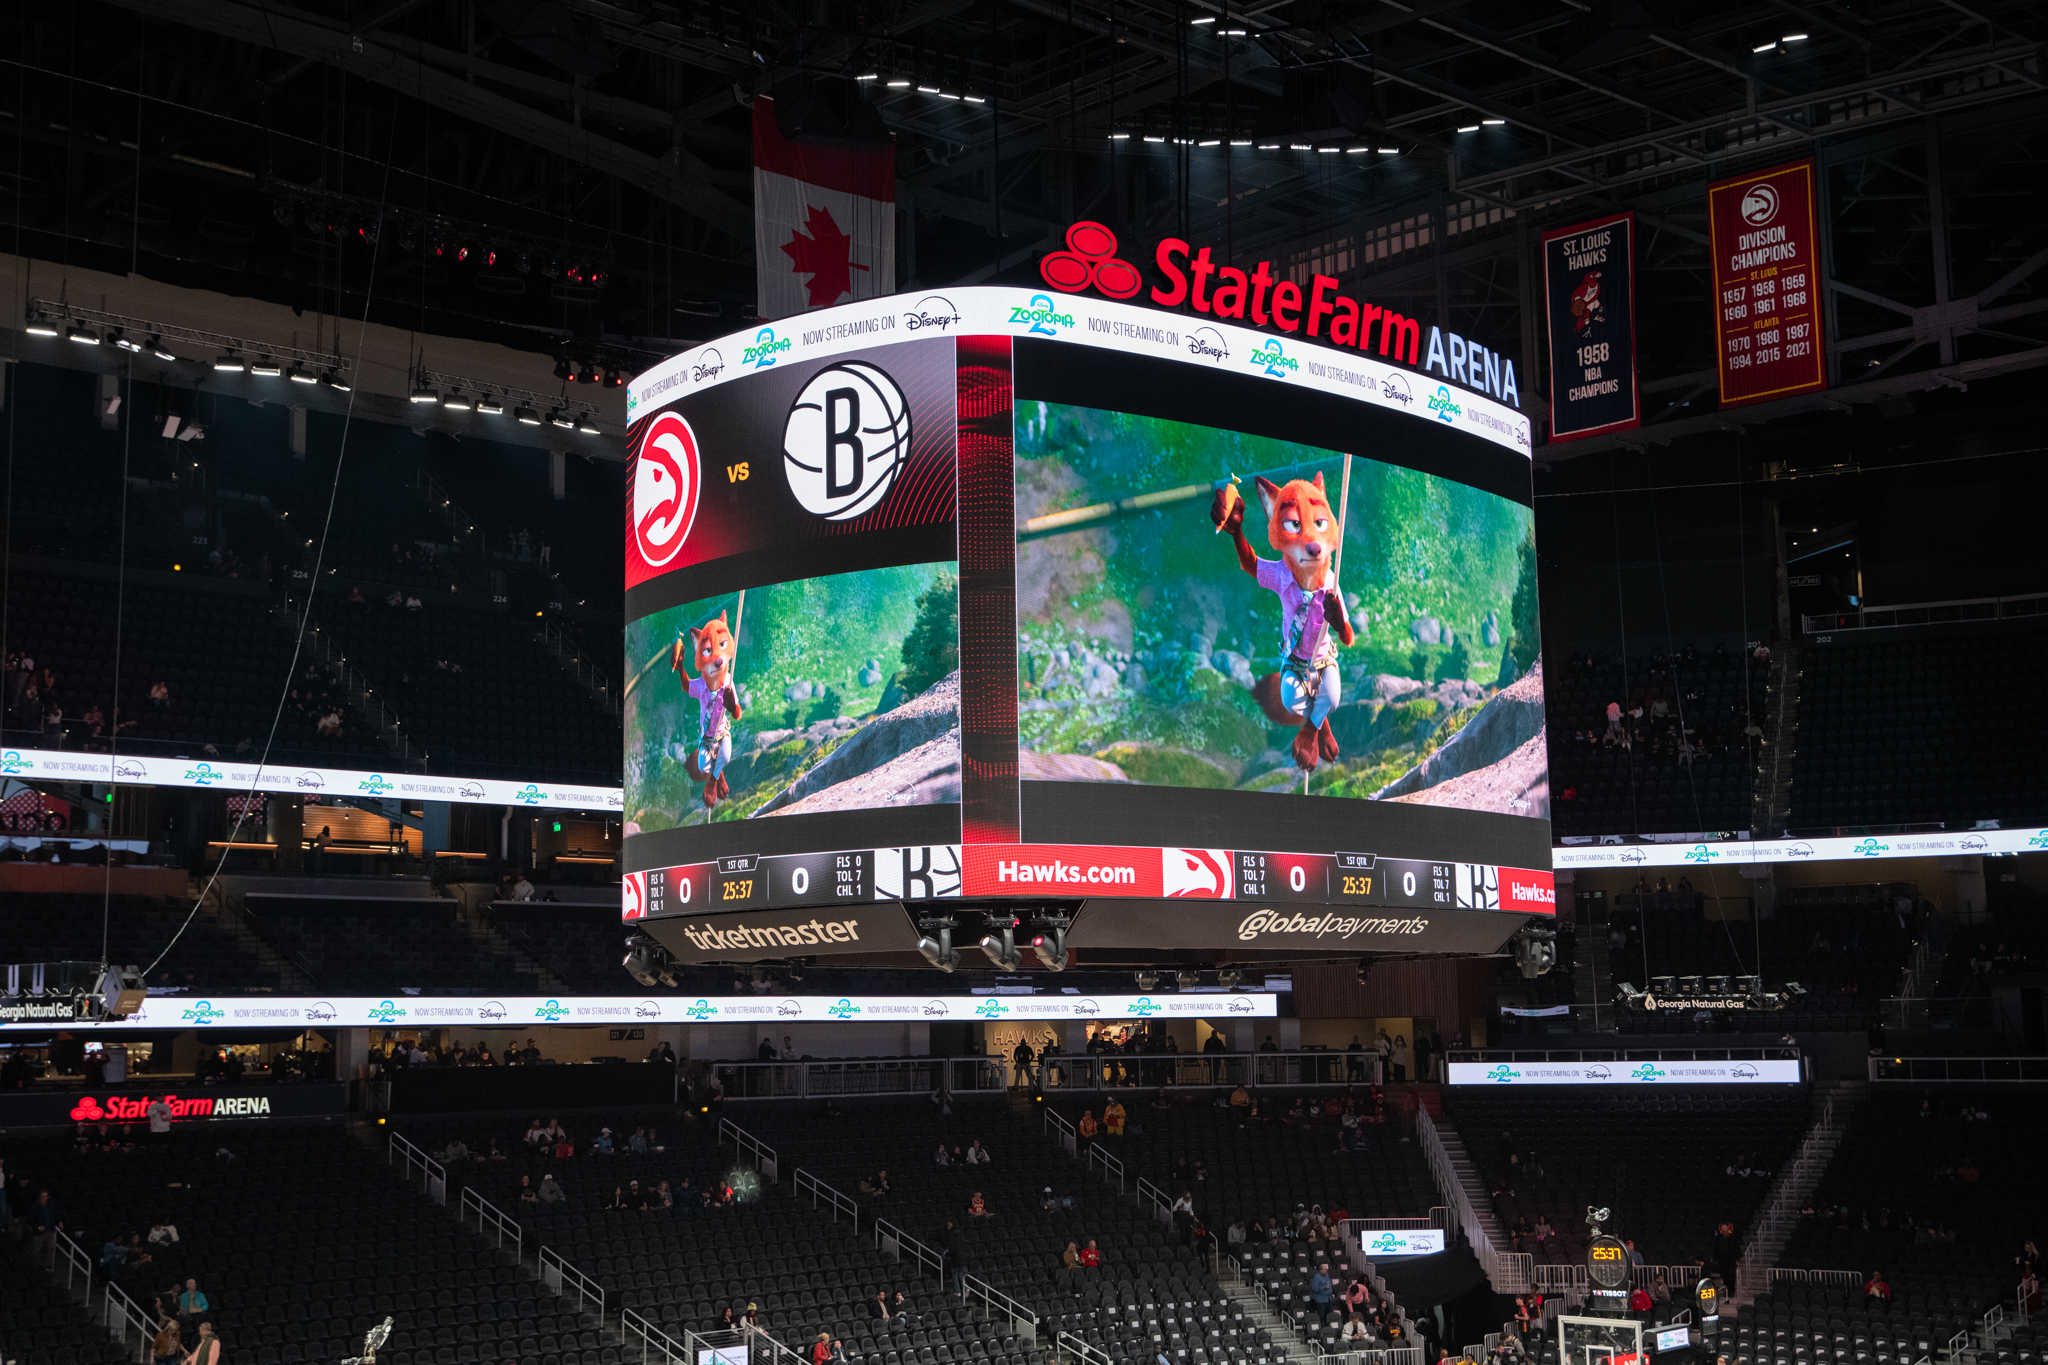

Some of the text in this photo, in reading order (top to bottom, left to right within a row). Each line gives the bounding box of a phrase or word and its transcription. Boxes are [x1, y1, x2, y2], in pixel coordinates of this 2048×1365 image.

[1563, 231, 1611, 256] ST. LOUIS
[1739, 225, 1786, 251] DIVISION
[1568, 248, 1607, 271] HAWKS
[1731, 242, 1796, 271] CHAMPIONS
[1750, 267, 1778, 281] ST. LOUIS
[1723, 273, 1805, 304] 1957 1958 1959
[1724, 291, 1806, 321] 1960 1961 1968
[1753, 317, 1779, 330] ATLANTA
[742, 337, 792, 365] ZOOTOPIA
[803, 329, 824, 346] NOW
[826, 320, 879, 340] STREAMING
[881, 315, 896, 330] ON
[903, 311, 961, 331] Disney+
[1008, 307, 1075, 328] ZOOTOPIA
[1088, 317, 1111, 334] NOW
[1113, 322, 1164, 343] STREAMING
[1166, 332, 1179, 346] ON
[1185, 335, 1230, 362] Disney+
[1727, 323, 1809, 353] 1970 1980 1987
[1577, 342, 1609, 366] 1958
[1729, 341, 1810, 370] 1994 2015 2021
[1426, 326, 1519, 408] ARENA
[1584, 366, 1602, 382] NBA
[641, 386, 651, 403] NOW
[651, 373, 679, 397] STREAMING
[679, 369, 688, 384] ON
[692, 364, 725, 382] Disney+
[1250, 349, 1299, 371] ZOOTOPIA
[1308, 361, 1326, 377] NOW
[1327, 366, 1365, 388] STREAMING
[1366, 377, 1377, 391] ON
[1381, 381, 1413, 407] Disney+
[1569, 379, 1619, 401] CHAMPIONS
[1427, 395, 1462, 417] ZOOTOPIA
[1467, 408, 1480, 423] NOW
[1480, 412, 1505, 432] STREAMING
[1505, 424, 1513, 437] ON
[727, 462, 750, 484] VS
[292, 570, 308, 579] 224
[493, 595, 507, 603] 224
[231, 773, 246, 782] NOW
[282, 776, 291, 784] ON
[295, 777, 326, 790] Disney+
[400, 783, 414, 792] NOW
[415, 784, 446, 794] STREAMING
[446, 786, 455, 794] ON
[458, 787, 486, 800] Disney+
[1897, 842, 1912, 850] NOW
[1912, 842, 1945, 850] STREAMING
[1946, 841, 1955, 849] ON
[1958, 840, 1989, 851] Disney+
[727, 859, 749, 869] 1ST QTR
[836, 855, 862, 868] FLS 0
[1243, 856, 1265, 867] FLS 0
[1346, 856, 1367, 866] 1ST QTR
[1561, 852, 1648, 864] NOW STREAMING ON Disney+
[650, 873, 664, 885] FLS 0
[836, 870, 862, 882] TOL 7
[998, 860, 1136, 884] Hawks.com
[1243, 869, 1266, 881] TOL 7
[1290, 866, 1306, 892] 0
[1433, 866, 1449, 877] FLS 0
[792, 867, 809, 895] 0
[1243, 883, 1266, 895] CHL 1
[1342, 876, 1372, 895] 25:37
[1403, 871, 1417, 897] 0
[1433, 879, 1450, 890] TOL 7
[650, 886, 664, 898] TOL 7
[679, 878, 692, 904] 0
[722, 880, 753, 900] 25:37
[836, 884, 862, 896] CHL 1
[1433, 891, 1450, 902] CHL 1
[1511, 881, 1556, 904] Hawks.co
[650, 900, 664, 911] CHL 1
[684, 918, 860, 951] ticketmaster
[0, 1002, 73, 1022] eorgia Natural Gas
[1657, 999, 1744, 1010] Georgia Natural Gas
[181, 1009, 225, 1020] ZOOTOPIA
[234, 1009, 251, 1018] NOW
[251, 1009, 289, 1018] STREAMING
[290, 1009, 300, 1017] ON
[304, 1008, 338, 1022] Disney+
[367, 1008, 508, 1021] ZOOTOPIA NOW STREAMING ON Disney+
[993, 1029, 1052, 1045] HAWKS
[213, 1097, 271, 1116] ARENA
[1593, 1247, 1621, 1260] 25:37
[1601, 1290, 1628, 1298] TISSOT
